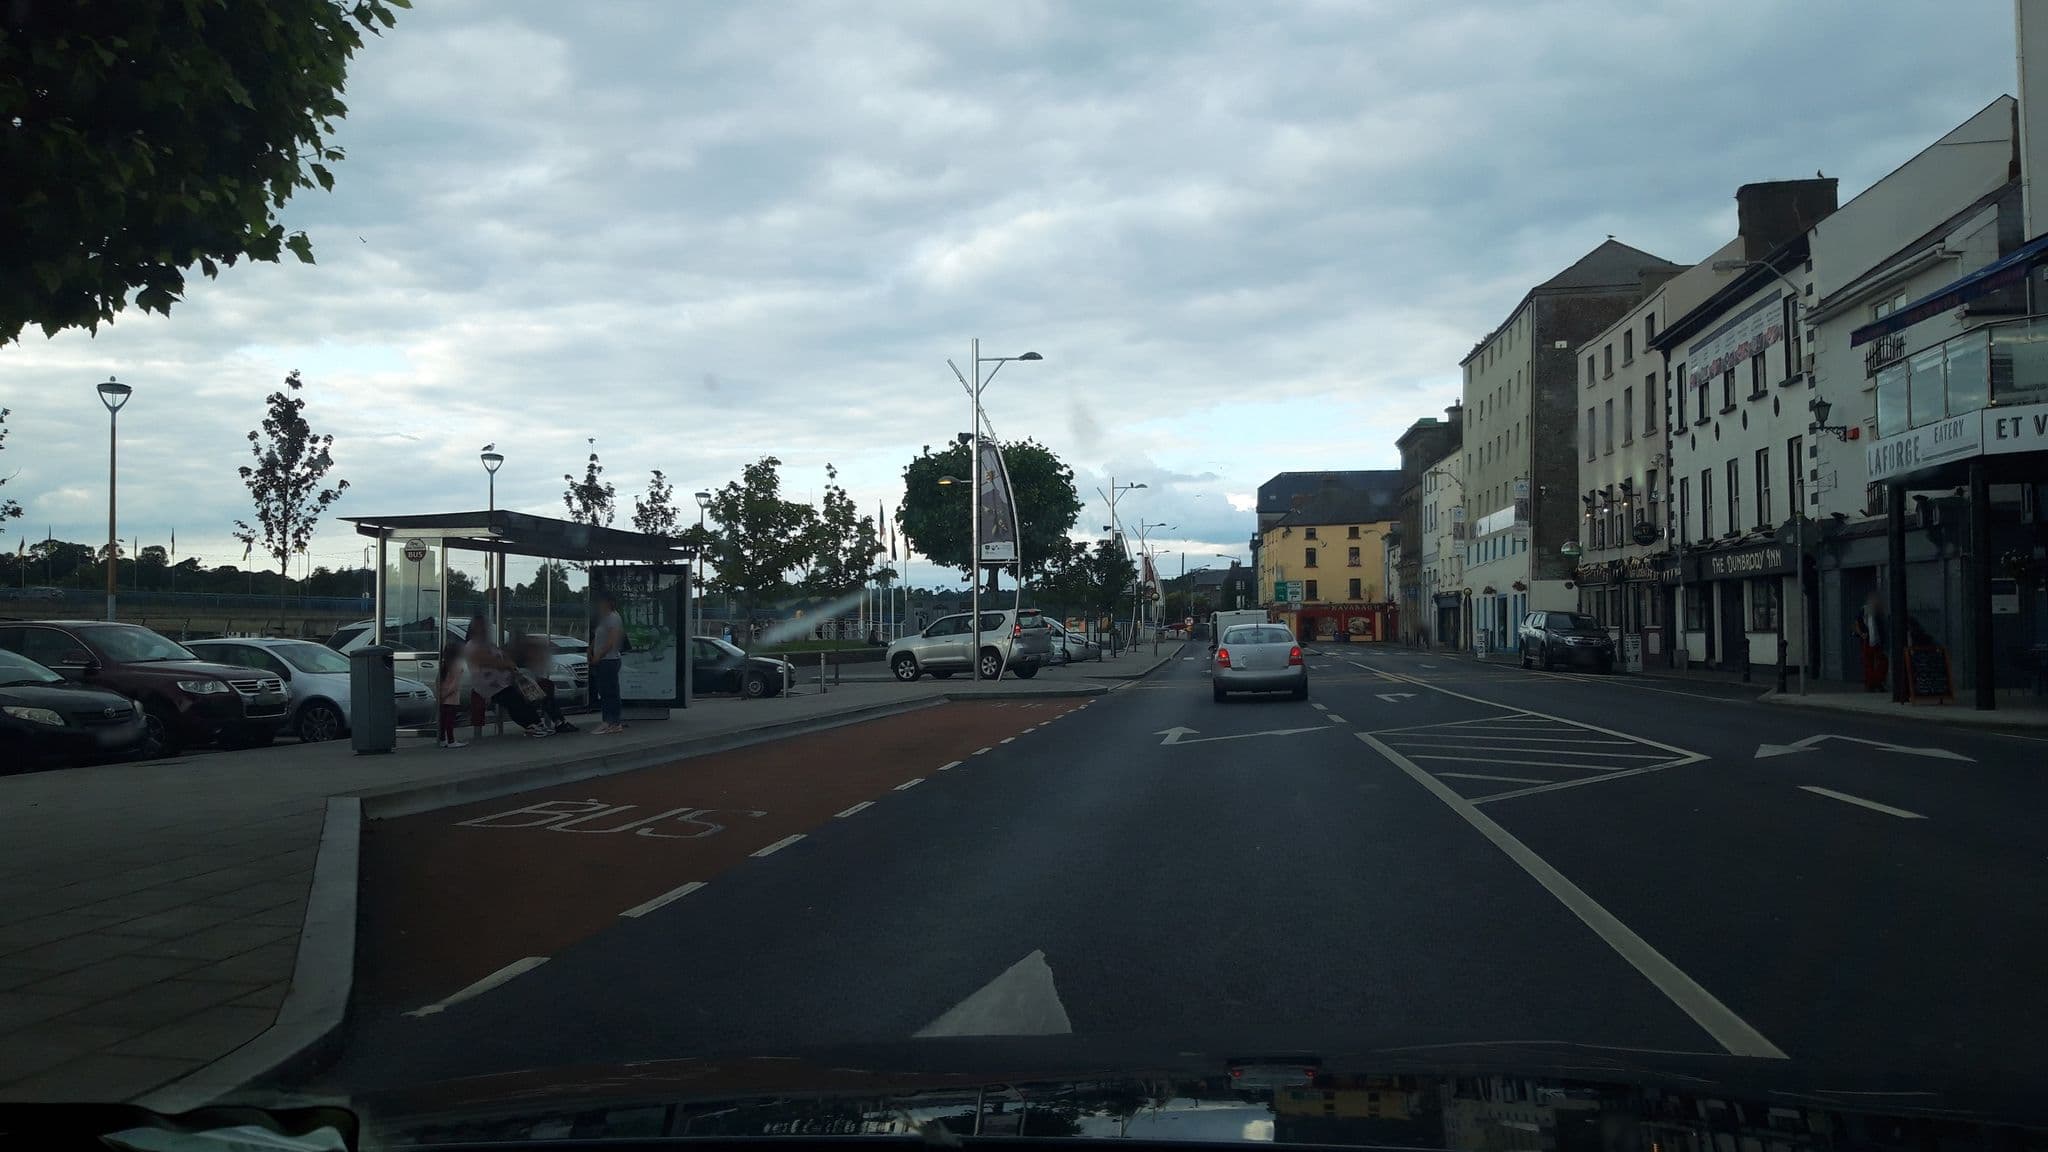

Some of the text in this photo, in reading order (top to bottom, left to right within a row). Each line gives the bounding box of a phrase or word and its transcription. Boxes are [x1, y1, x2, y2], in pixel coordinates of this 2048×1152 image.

[1996, 416, 2023, 440] ET
[1867, 418, 1965, 477] LAFORGE EATERY
[407, 551, 425, 560] BUS
[452, 798, 766, 839] BUS
